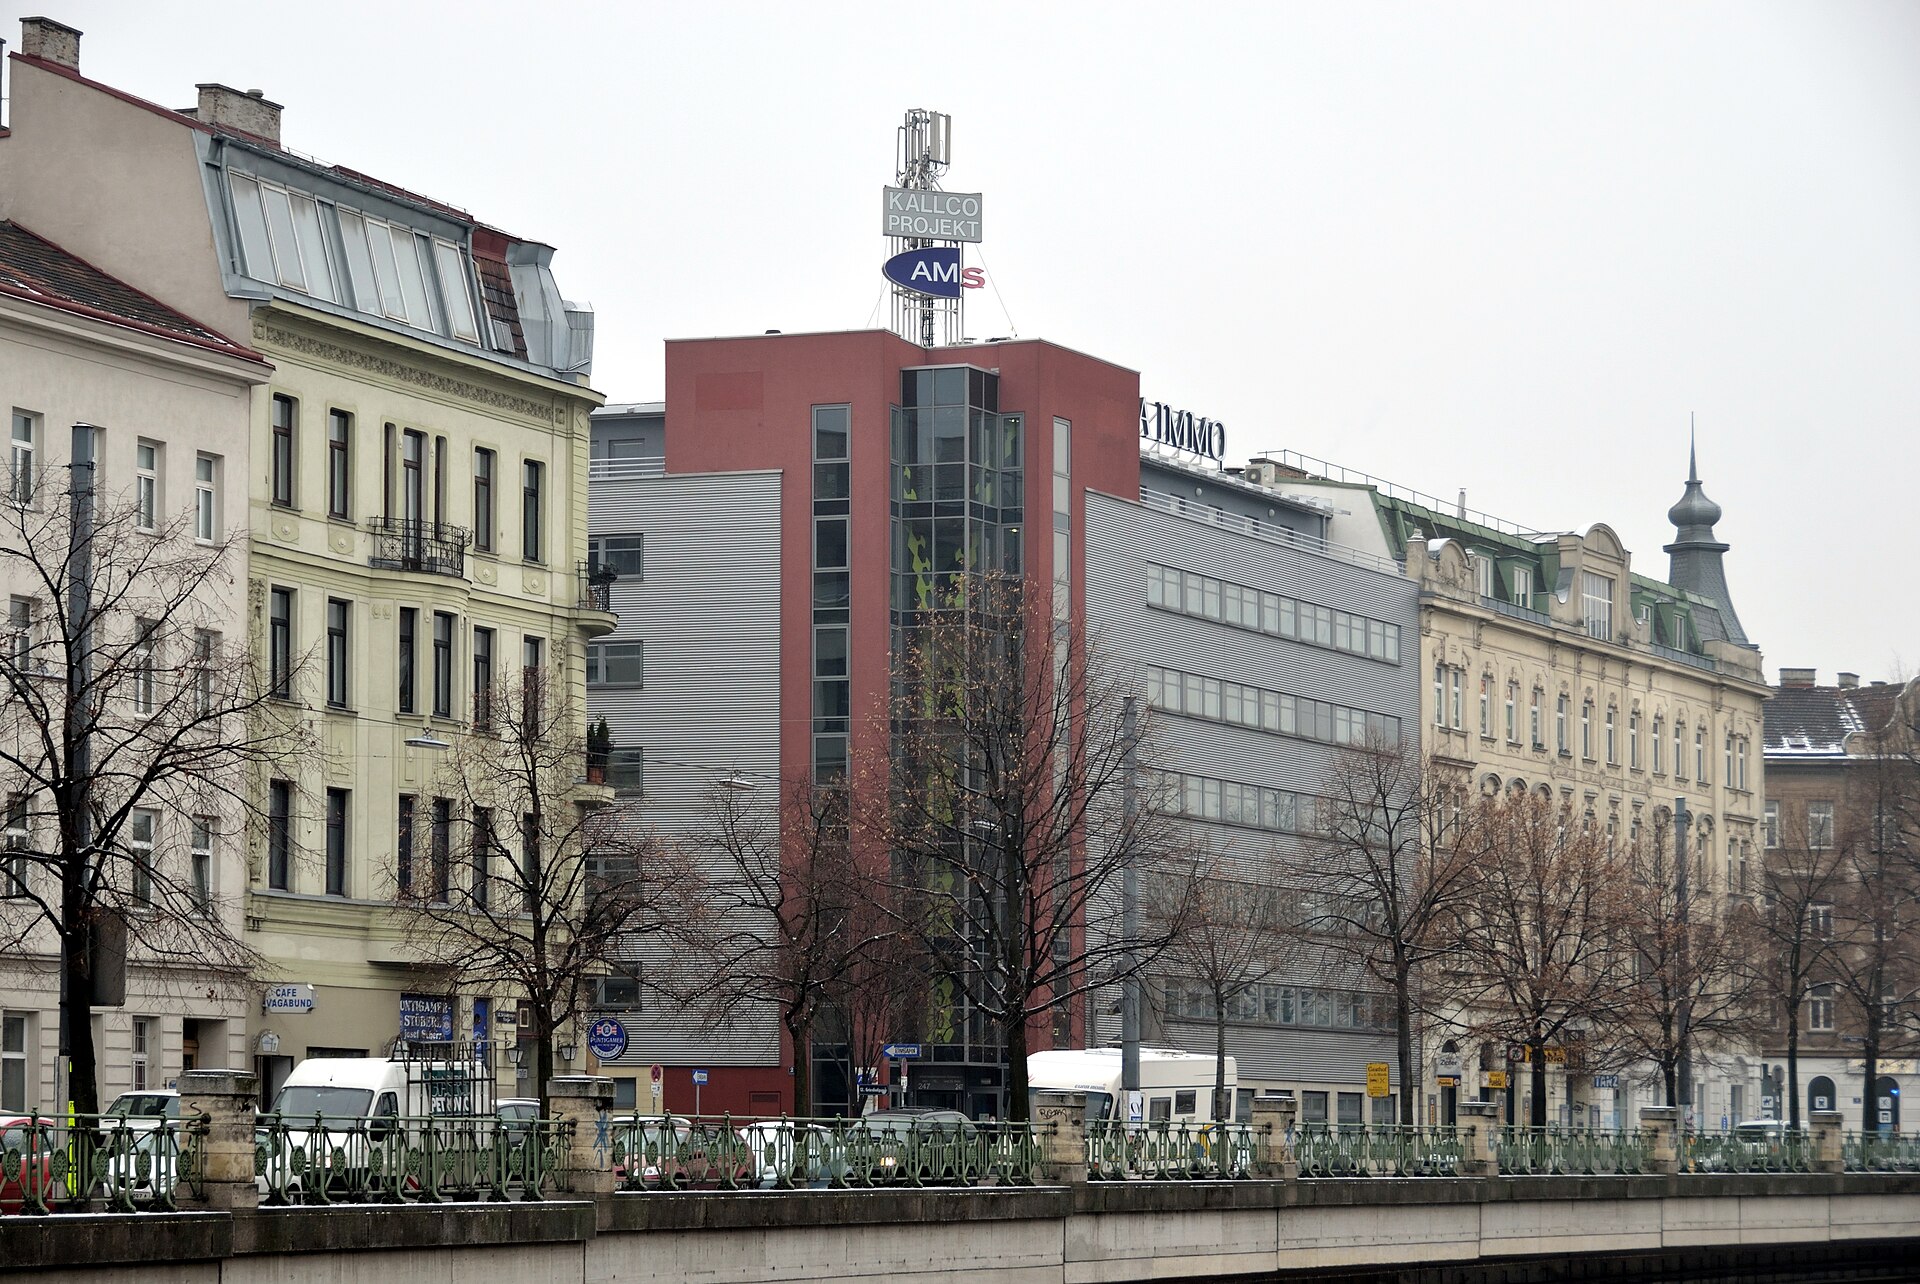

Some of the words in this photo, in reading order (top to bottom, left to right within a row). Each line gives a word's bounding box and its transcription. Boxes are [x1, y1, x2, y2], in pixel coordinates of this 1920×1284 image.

[888, 191, 980, 218] KALLCO
[887, 214, 980, 238] PROJEKT
[910, 260, 986, 290] AMS
[1139, 397, 1150, 438] A
[1155, 401, 1227, 462] IMMO
[275, 988, 297, 997] CAFE
[266, 999, 312, 1008] VAGABUND
[400, 1000, 452, 1014] UNTIGAMER-
[918, 1082, 931, 1090] 247
